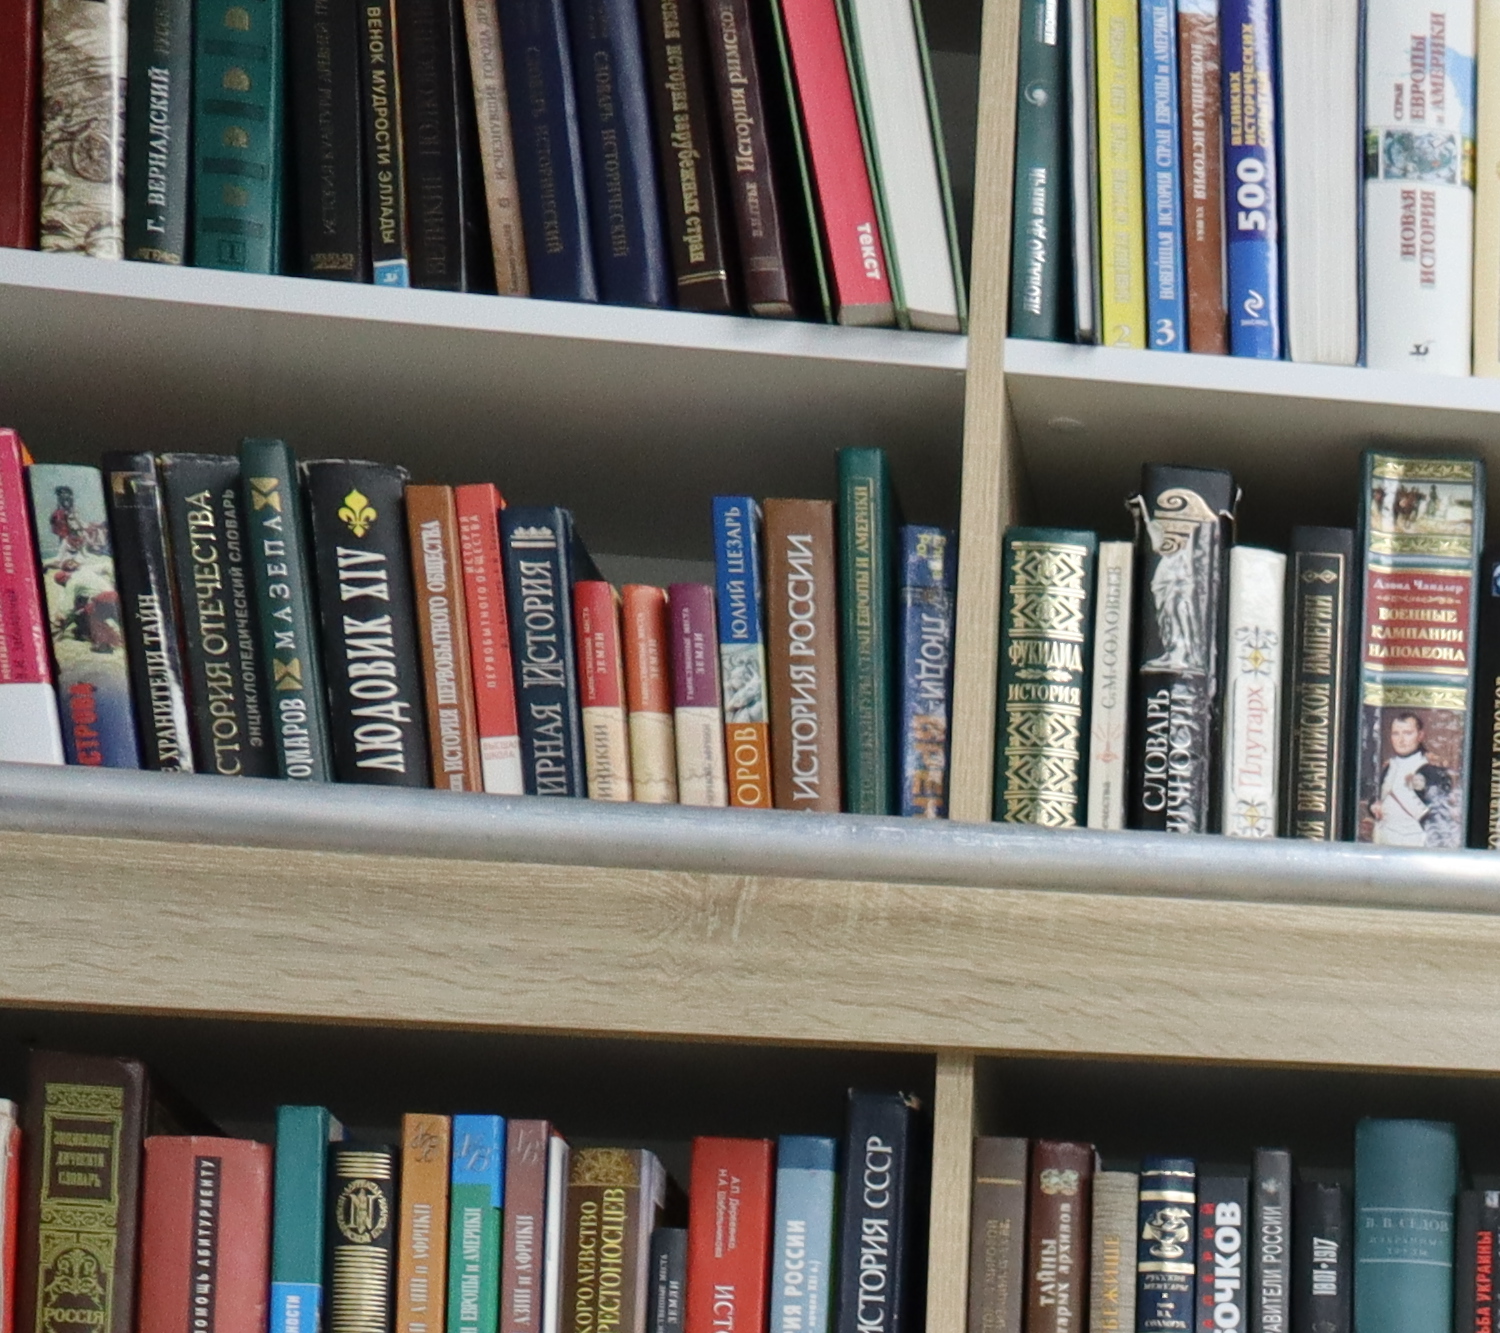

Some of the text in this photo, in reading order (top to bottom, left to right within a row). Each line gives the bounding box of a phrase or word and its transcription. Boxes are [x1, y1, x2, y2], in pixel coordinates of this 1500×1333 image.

[147, 66, 169, 234] Г. ВЕРНАДСКИЙ
[1237, 158, 1266, 231] 500
[1400, 189, 1416, 258] НОВАЯ
[1420, 190, 1435, 285] ИСТОРИЯ
[724, 506, 748, 639] ЮЛИЙ ЦЕЗАРЬ
[185, 490, 243, 778] СТОРИЯ ОТЕЧЕСТВА
[336, 546, 409, 772] ЛЮДОВИК XIV
[787, 534, 819, 799] ИСТОРИЯ РОССИИ
[1239, 686, 1266, 787] Плутарх
[863, 1137, 892, 1208] СССР
